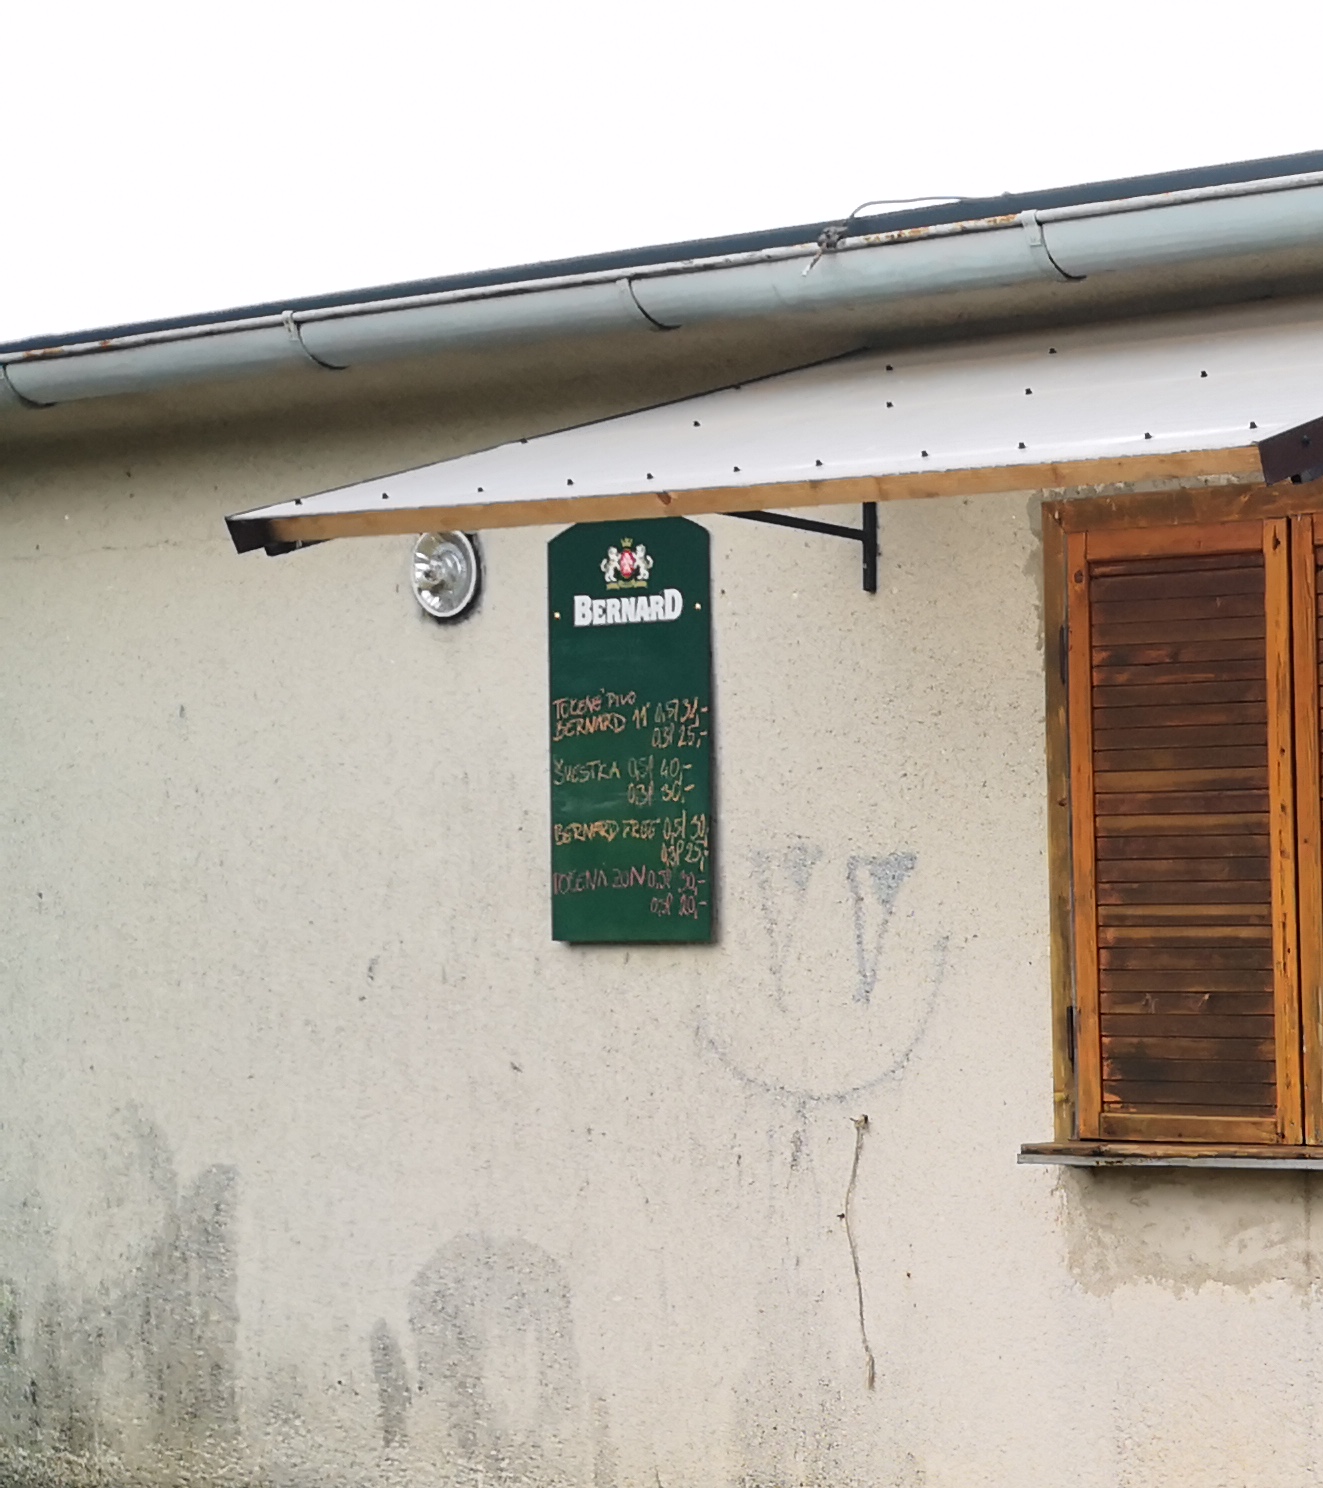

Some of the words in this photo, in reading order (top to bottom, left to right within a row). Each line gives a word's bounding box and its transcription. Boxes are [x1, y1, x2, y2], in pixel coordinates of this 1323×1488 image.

[573, 588, 683, 627] BERNARD
[552, 712, 627, 742] BERNARD
[554, 820, 620, 845] BERNARD
